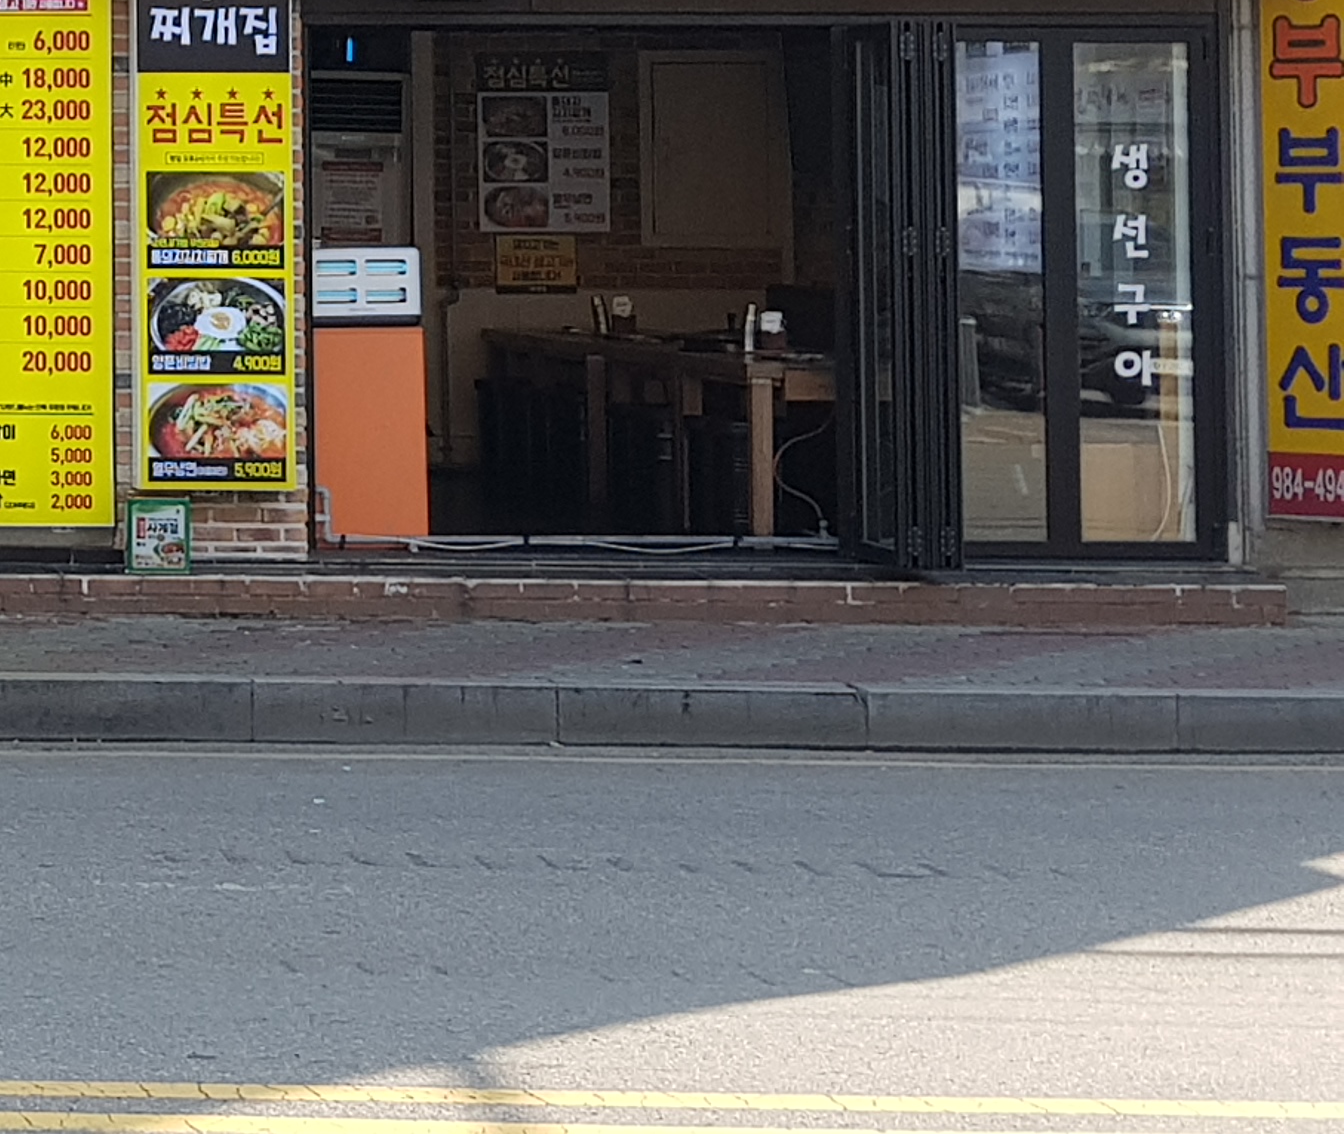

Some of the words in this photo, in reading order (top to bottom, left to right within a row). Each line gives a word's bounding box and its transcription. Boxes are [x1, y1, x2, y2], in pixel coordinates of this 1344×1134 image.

[33, 30, 90, 54] 6,000
[149, 6, 279, 56] 찌개집
[0, 71, 13, 88] 中
[21, 67, 90, 92] 18,000
[0, 103, 13, 119] 大
[21, 99, 90, 124] 23,000
[146, 101, 285, 145] 점심특선
[21, 136, 91, 162] 12,000
[22, 172, 91, 198] 12,000
[22, 208, 91, 233] 12,000
[33, 243, 91, 269] 7,000
[1111, 143, 1154, 387] 생선구이
[23, 279, 91, 305] 10,000
[23, 314, 91, 340] 10,000
[22, 350, 91, 376] 20,000
[232, 355, 282, 371] 4,900원
[51, 424, 92, 443] 6,000
[51, 448, 92, 466] 5,000
[51, 471, 92, 490] 3,000
[51, 493, 92, 512] 2,000
